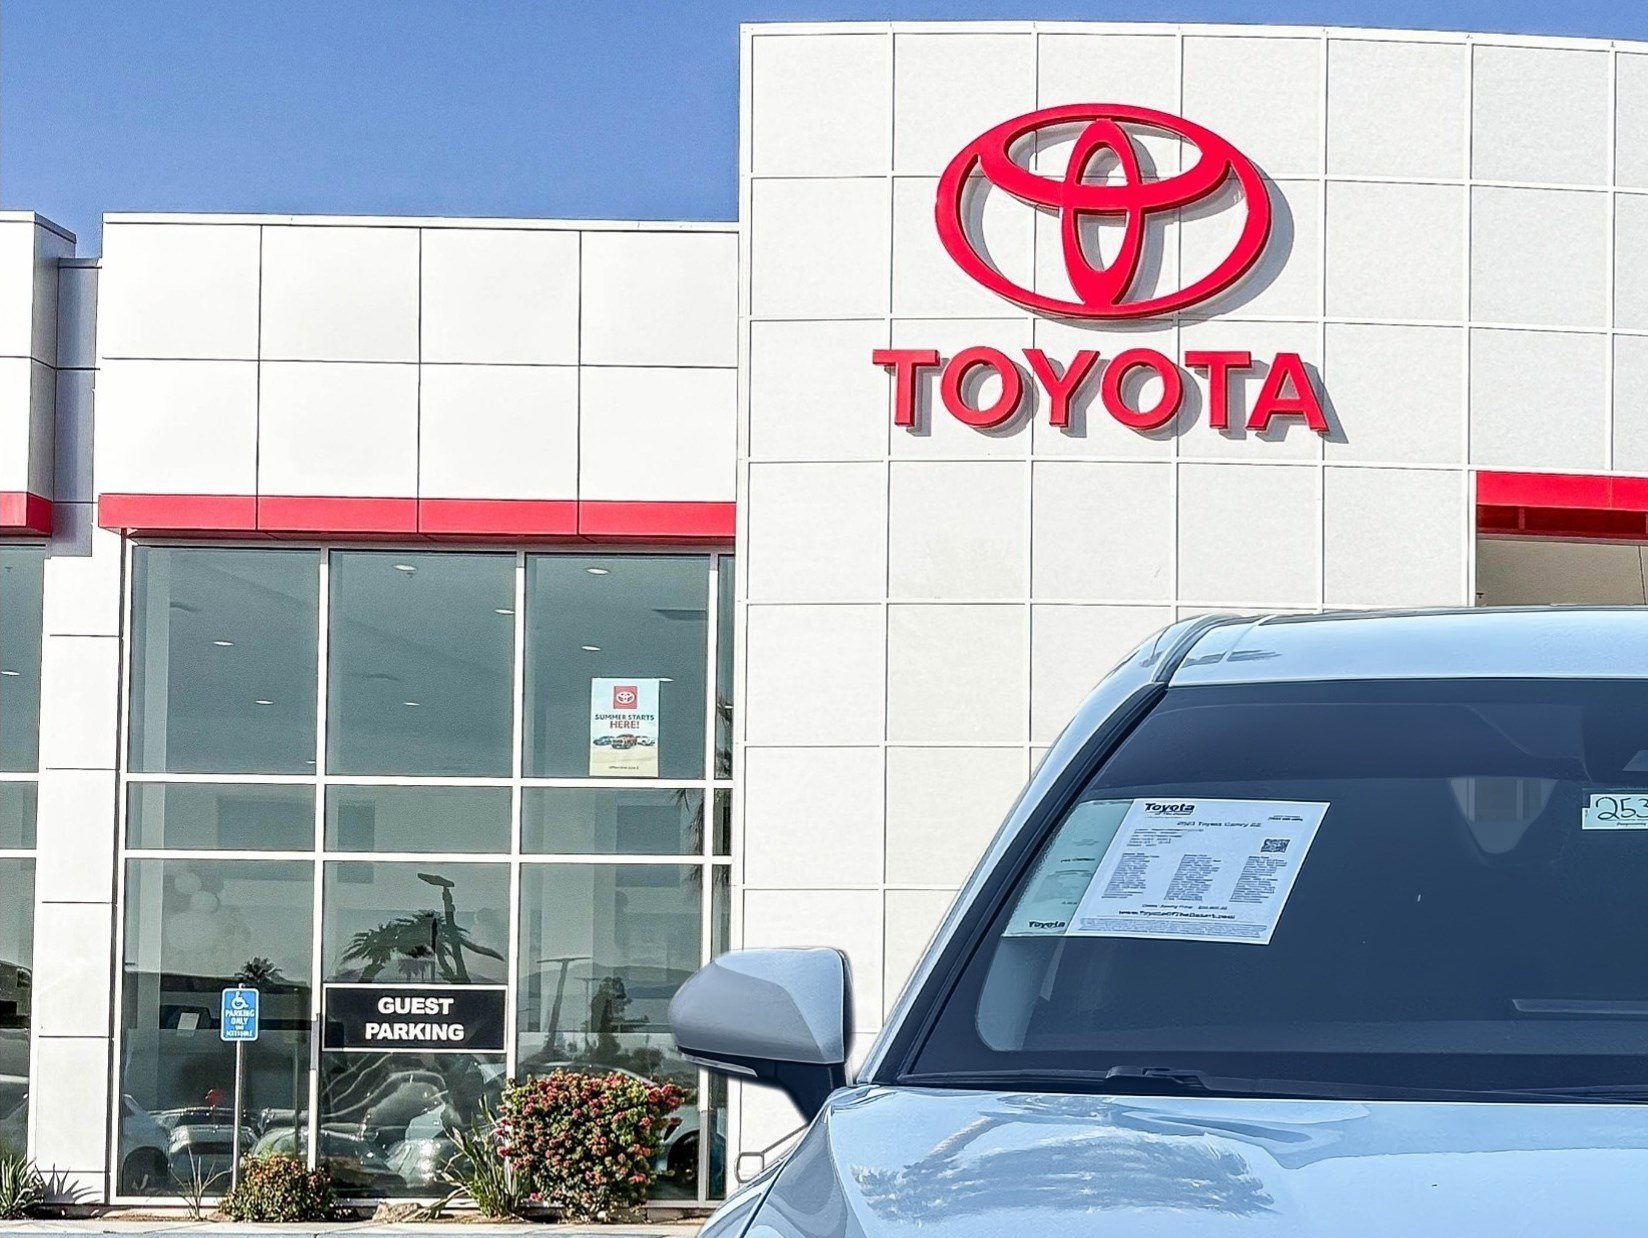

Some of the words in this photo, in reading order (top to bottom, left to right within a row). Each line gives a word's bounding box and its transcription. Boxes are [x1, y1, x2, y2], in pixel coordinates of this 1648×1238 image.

[872, 346, 1329, 431] TOYOTA
[609, 720, 640, 729] HERE!
[1144, 802, 1195, 813] Toyota
[378, 997, 455, 1015] GUEST
[225, 1009, 255, 1017] PARKING
[230, 1017, 249, 1025] ONLY
[365, 1022, 465, 1041] PARKING
